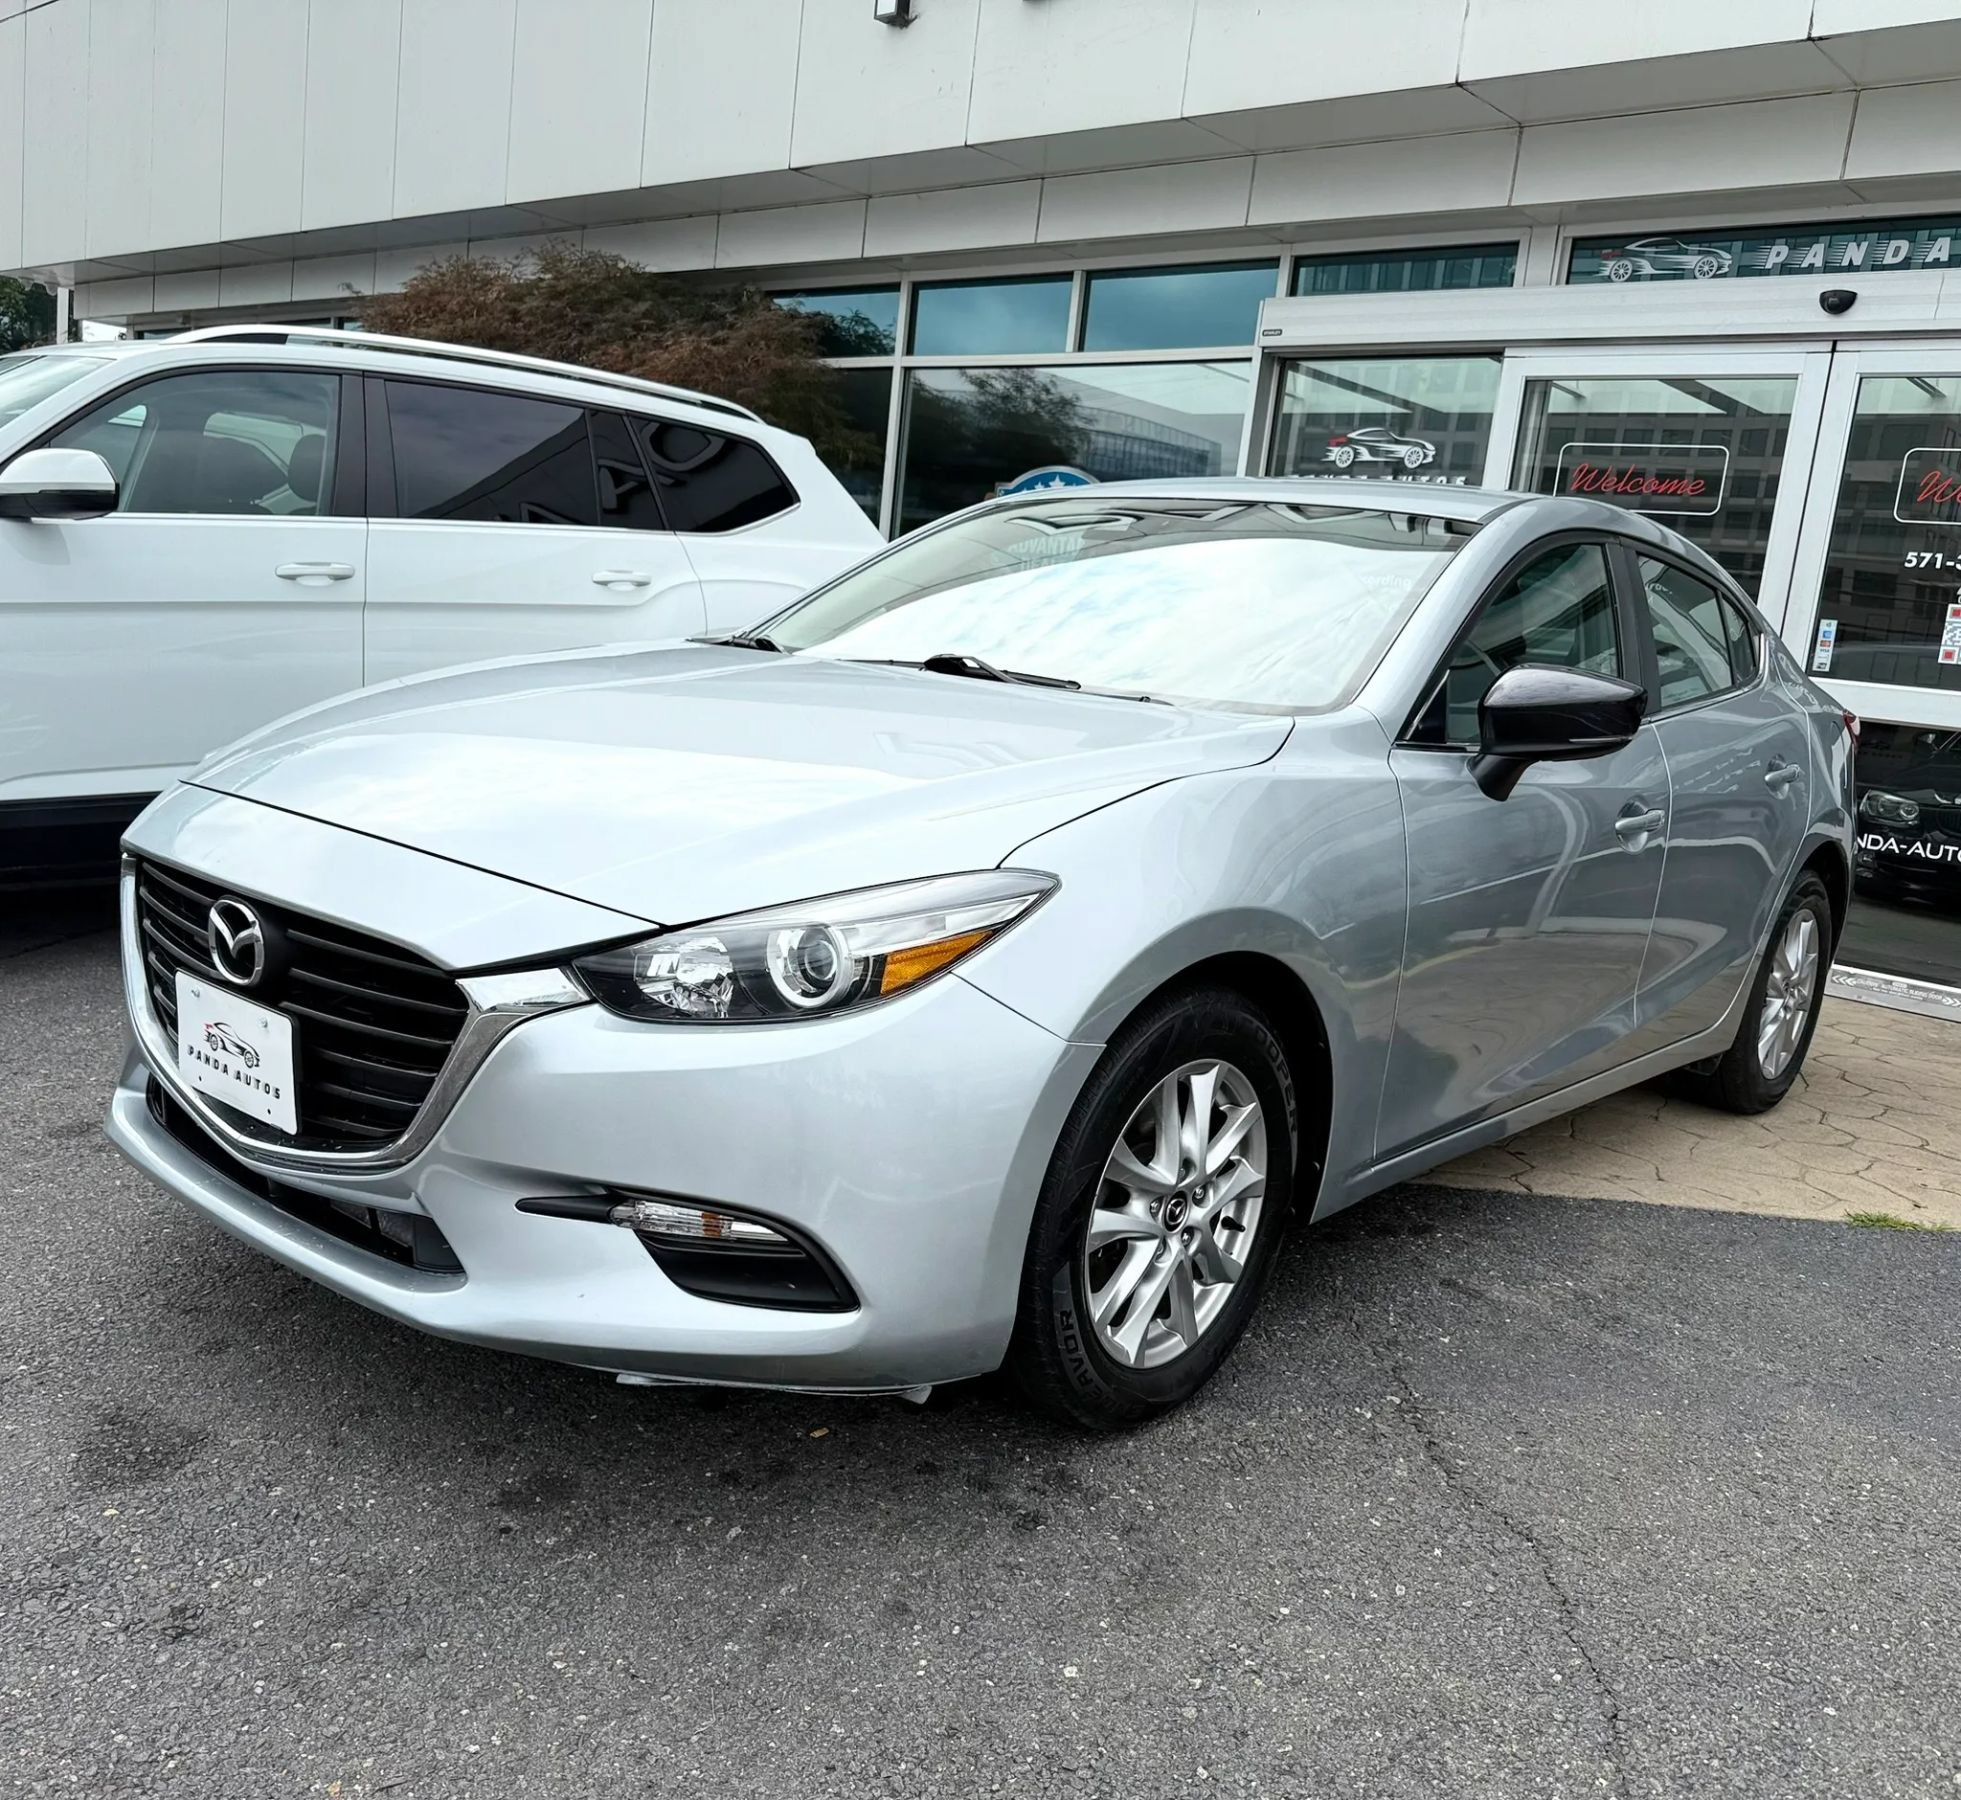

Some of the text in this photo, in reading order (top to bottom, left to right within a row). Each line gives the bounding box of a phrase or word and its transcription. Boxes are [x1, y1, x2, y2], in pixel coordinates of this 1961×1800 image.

[1753, 237, 1951, 269] PANDA
[1570, 463, 1706, 495] Welcome
[187, 1045, 281, 1100] PANDA AUTOS
